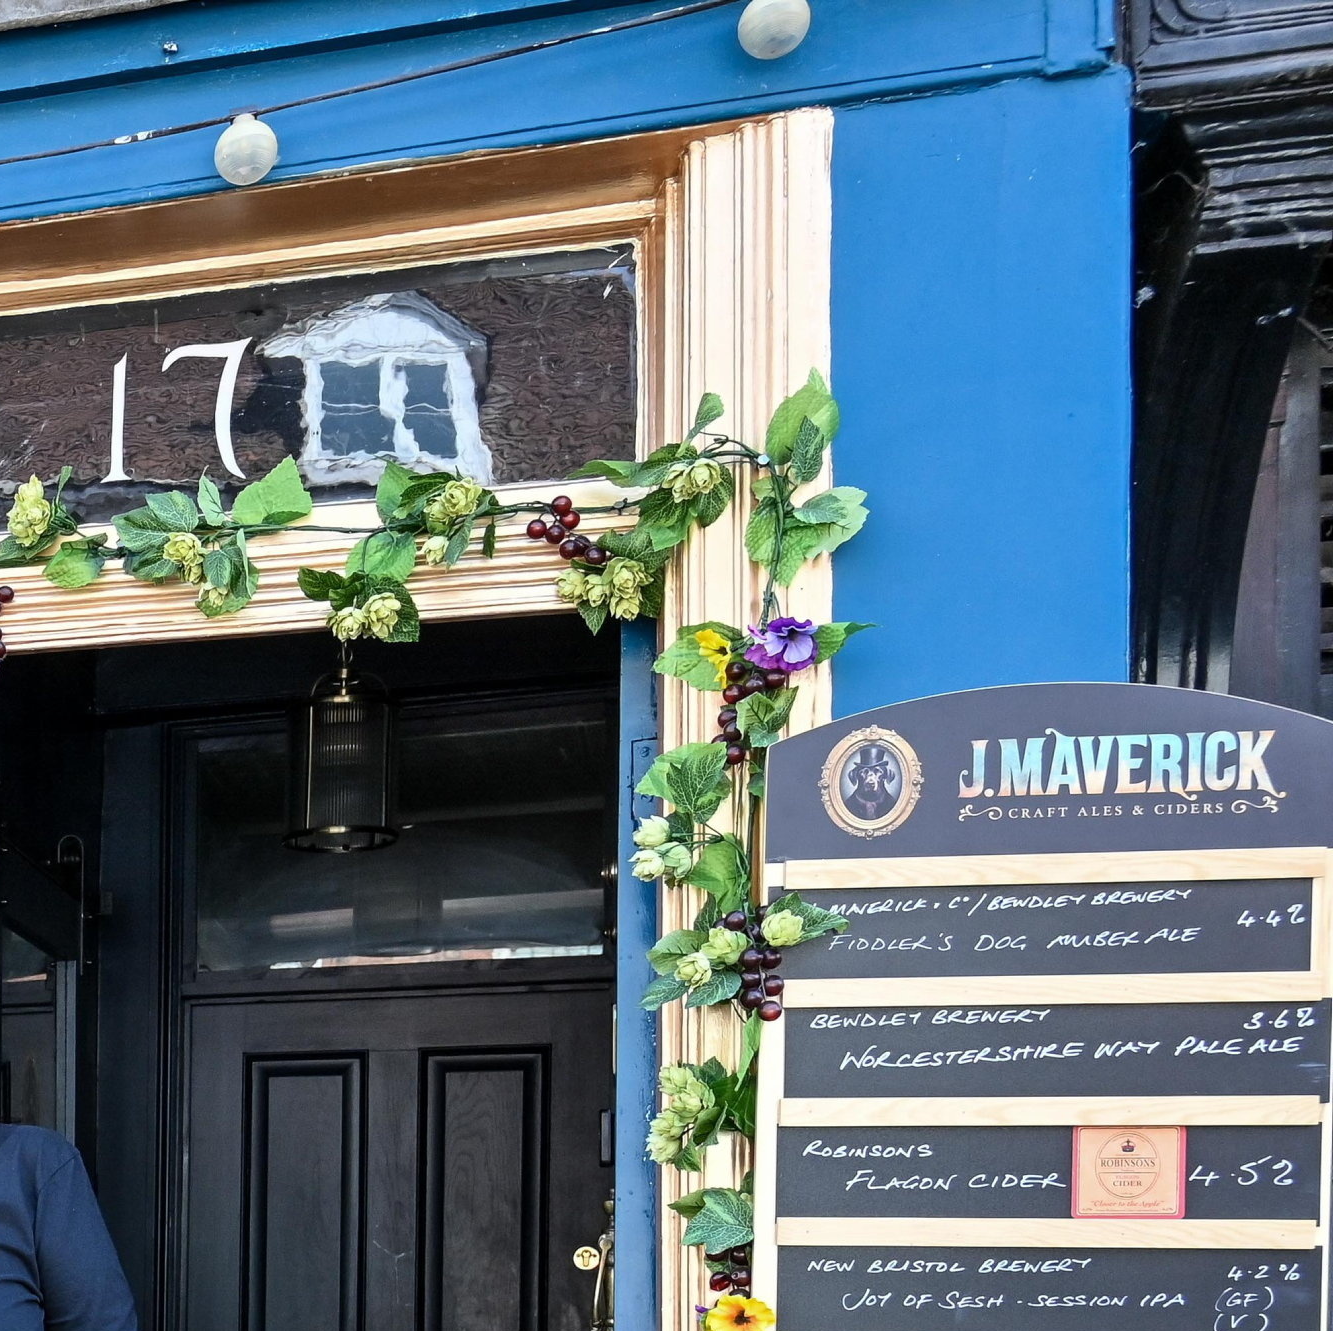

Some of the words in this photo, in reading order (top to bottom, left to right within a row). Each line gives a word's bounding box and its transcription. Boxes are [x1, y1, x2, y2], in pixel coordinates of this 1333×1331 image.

[102, 337, 252, 484] 17
[959, 728, 1286, 801] J.MAVERICK
[1008, 807, 1068, 819] CRAFT
[1078, 805, 1123, 817] ALES
[1132, 805, 1144, 816] &
[1154, 803, 1224, 816] CIDERS
[829, 898, 927, 916] MAVERICK
[1091, 889, 1192, 905] BREWERY
[829, 933, 953, 951] FIDDLER'S
[974, 935, 1026, 951] DOG
[1047, 931, 1139, 948] AMBER
[1144, 928, 1201, 943] ALE
[810, 1012, 921, 1028] BEWDLEY
[932, 1009, 1050, 1024] BREWERY
[840, 1043, 1084, 1070] WORCESTERSHIRE
[1094, 1041, 1160, 1058] WAY
[1174, 1036, 1243, 1056] PALE
[1248, 1037, 1304, 1053] ALE
[803, 1140, 932, 1158] ROBINSONS
[1101, 1159, 1156, 1168] ROBINSONS
[846, 1170, 957, 1191] FLAGON
[969, 1173, 1066, 1188] CIDER
[808, 1259, 855, 1271] NEW
[867, 1260, 965, 1273] BRISTOL
[978, 1258, 1091, 1273] BREWERY
[843, 1289, 892, 1310] JOY
[904, 1294, 932, 1309] OF
[938, 1291, 1003, 1309] SESH
[1028, 1295, 1128, 1306] SESSION
[1140, 1293, 1184, 1307] IPA
